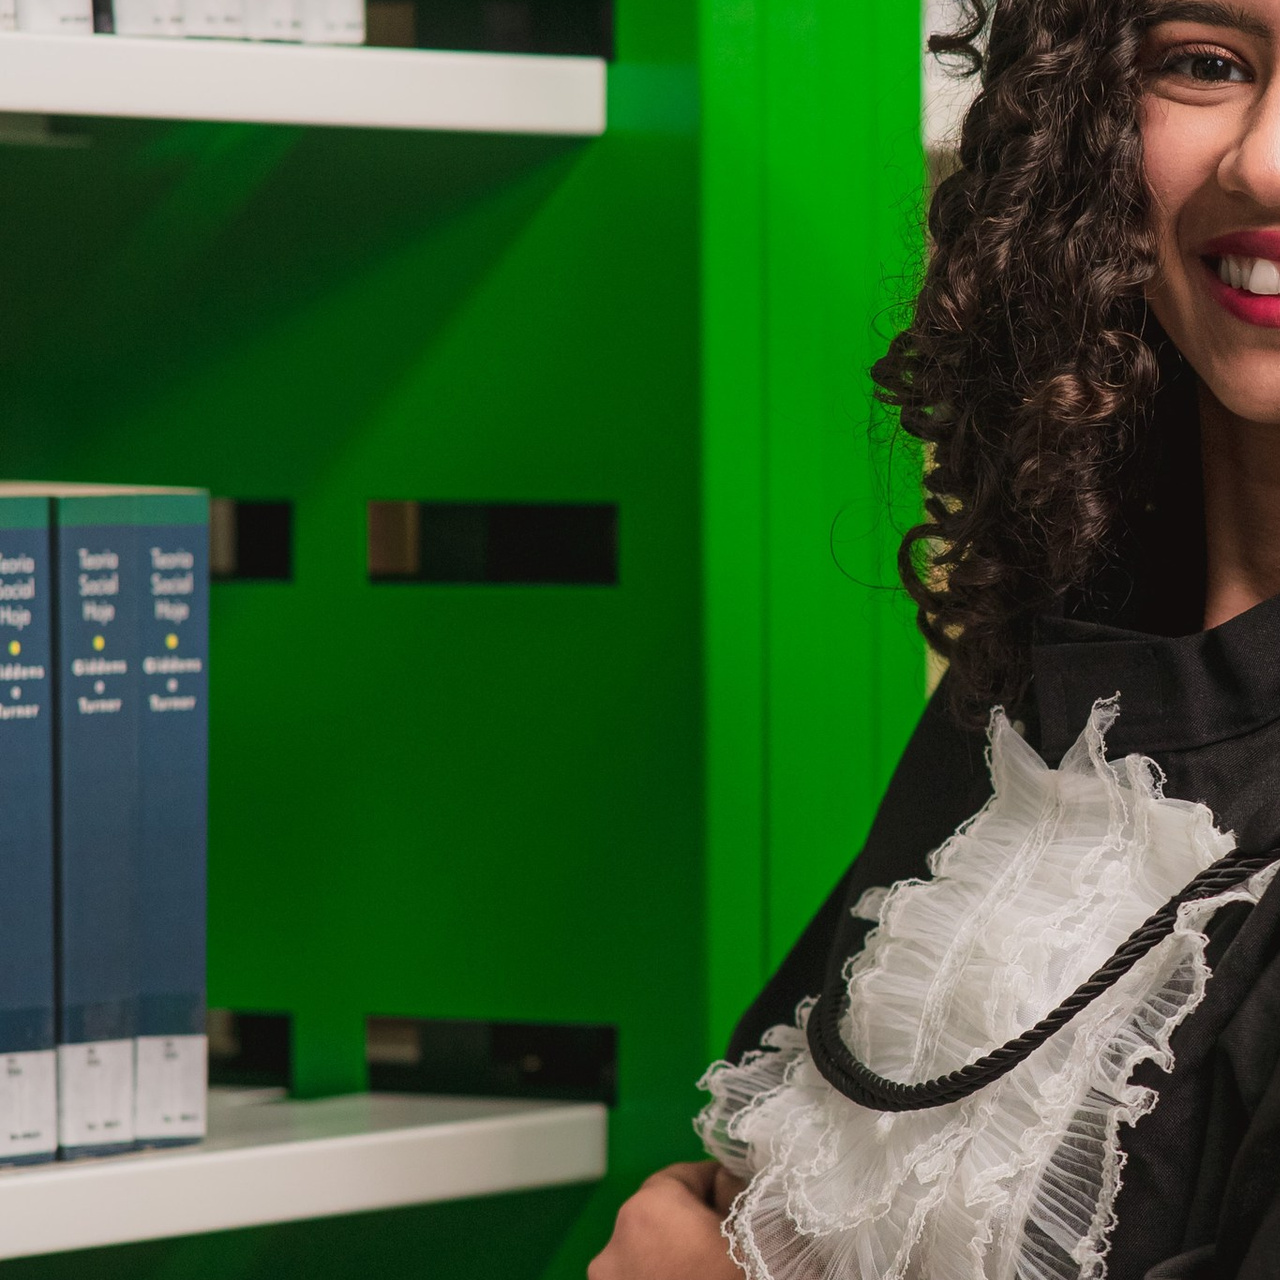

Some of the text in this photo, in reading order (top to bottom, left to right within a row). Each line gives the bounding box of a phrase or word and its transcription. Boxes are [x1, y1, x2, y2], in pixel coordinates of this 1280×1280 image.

[78, 548, 119, 570] Teoria
[151, 547, 194, 570] Teoria
[79, 572, 119, 596] Social
[151, 572, 194, 596] Social
[82, 600, 115, 626] Hoje
[154, 599, 190, 625] Hoje
[0, 663, 45, 680] iddens
[72, 657, 127, 677] Giddens
[143, 656, 203, 675] Giddens
[78, 696, 122, 714] Turner
[149, 694, 196, 712] Turner
